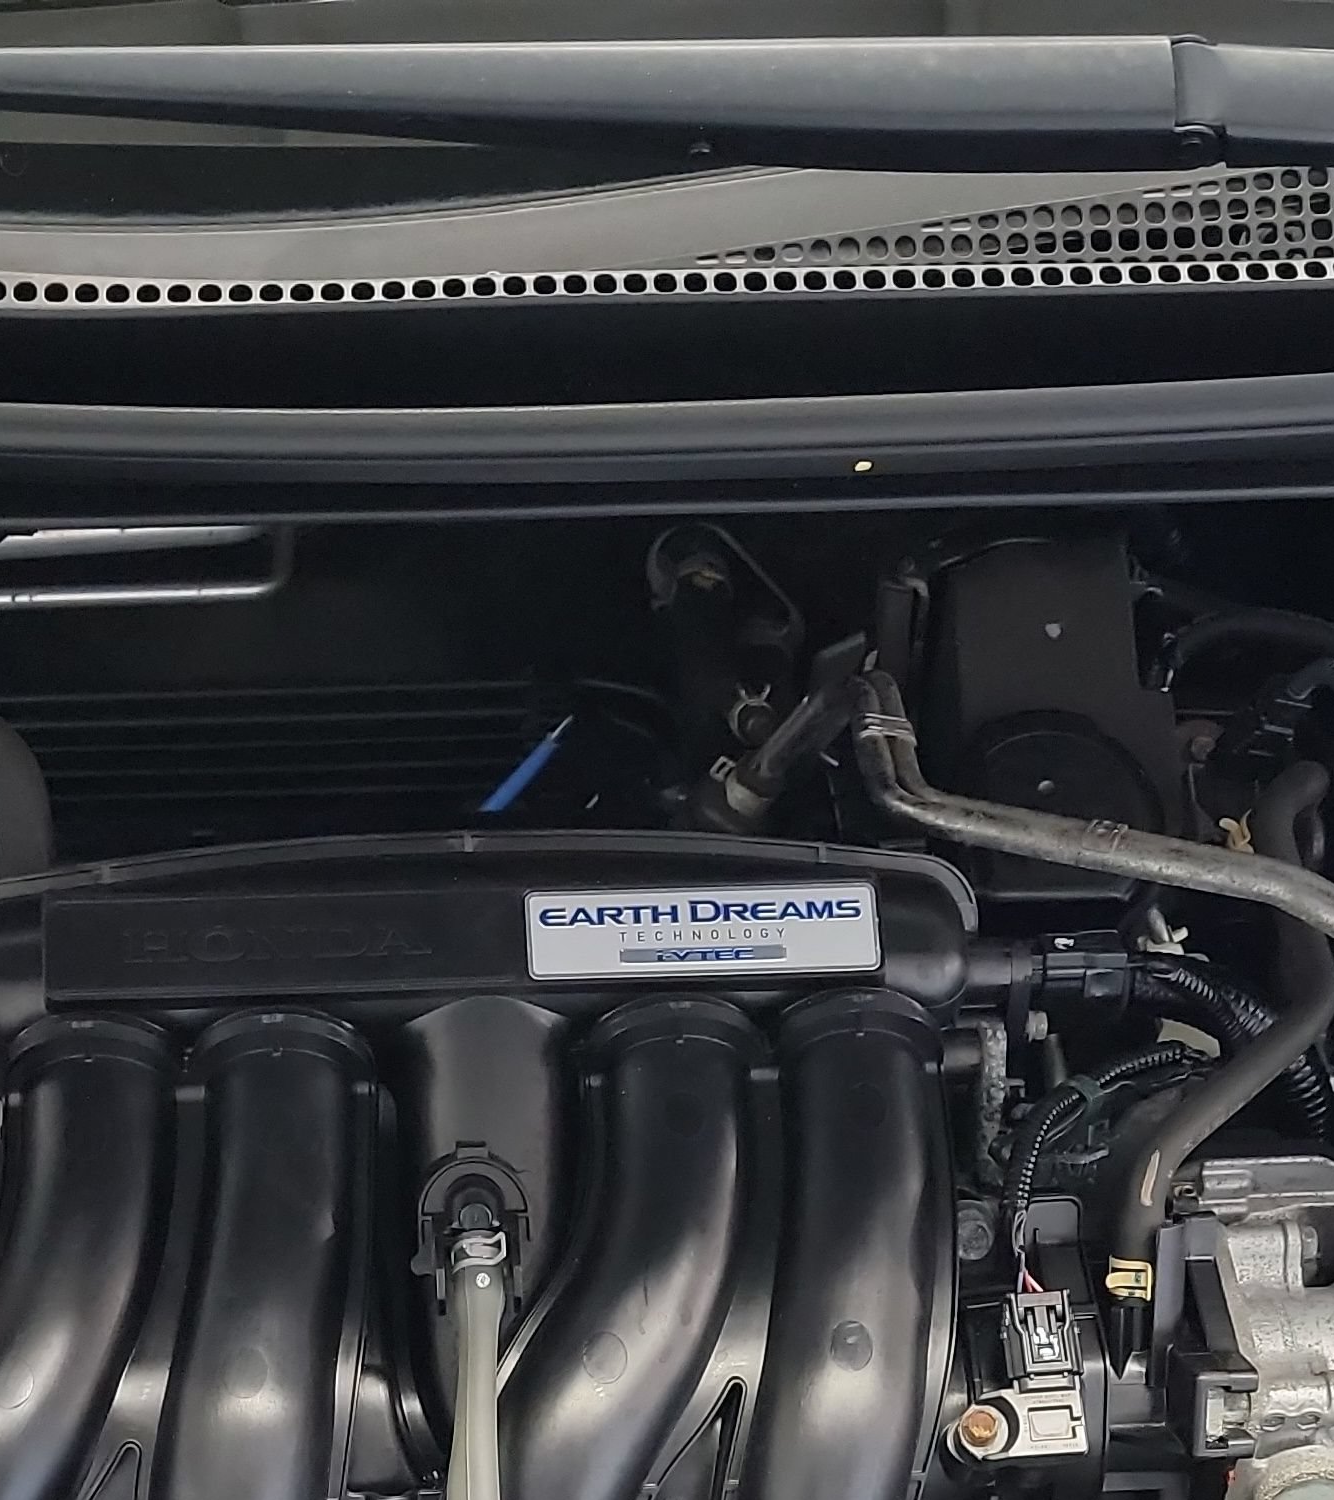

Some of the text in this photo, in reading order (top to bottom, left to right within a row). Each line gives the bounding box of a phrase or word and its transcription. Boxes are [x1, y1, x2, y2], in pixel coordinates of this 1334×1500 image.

[538, 899, 863, 928] EARTH DREAMS
[123, 925, 433, 964] HONDA
[619, 926, 787, 942] TECHNOLOGY
[656, 947, 756, 962] i-VTEC
